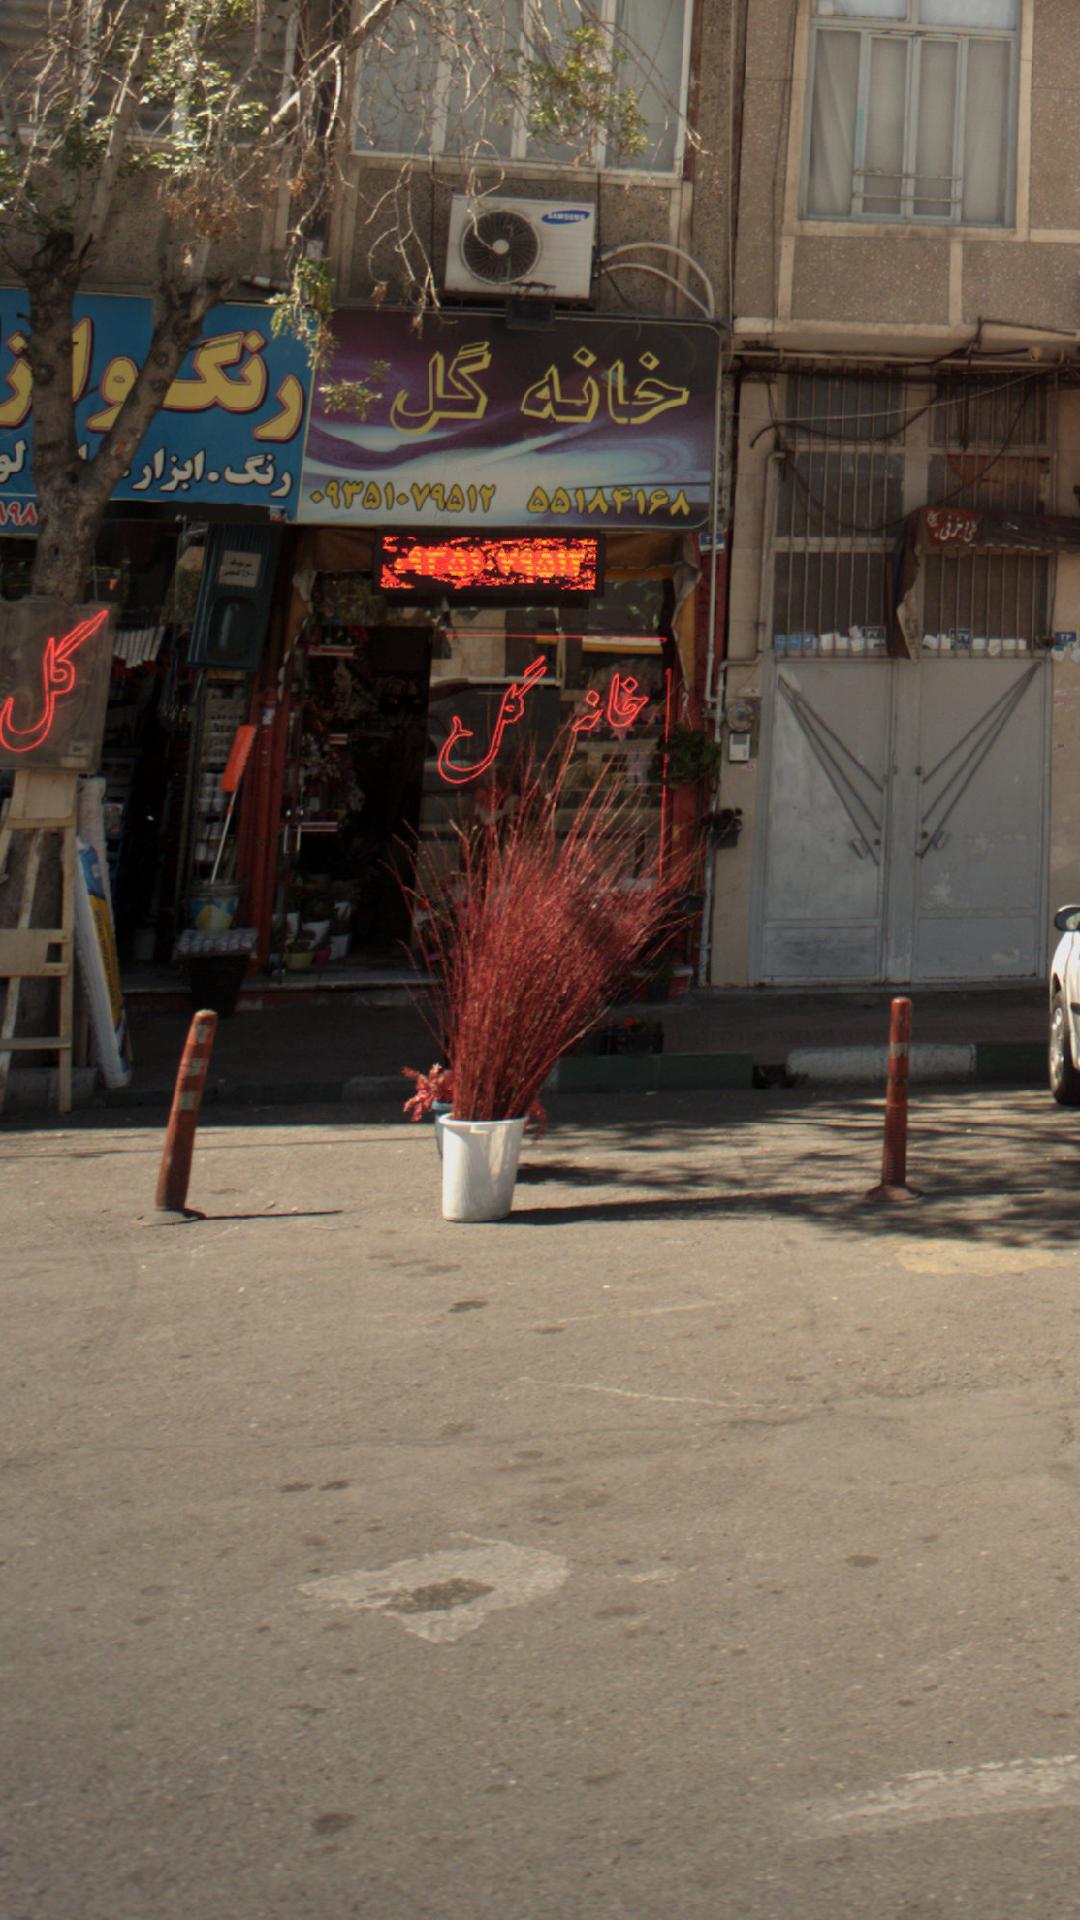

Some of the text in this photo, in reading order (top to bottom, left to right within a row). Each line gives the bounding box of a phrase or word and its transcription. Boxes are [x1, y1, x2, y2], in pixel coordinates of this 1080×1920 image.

[390, 341, 690, 435] خانه گل
[309, 479, 497, 513] ۰۹۳۵۱۰۷۹۵۱۲
[527, 485, 690, 517] ۵۵۱۸۴۱۶۸
[0, 609, 108, 752] گل
[437, 655, 649, 784] خانه گل
